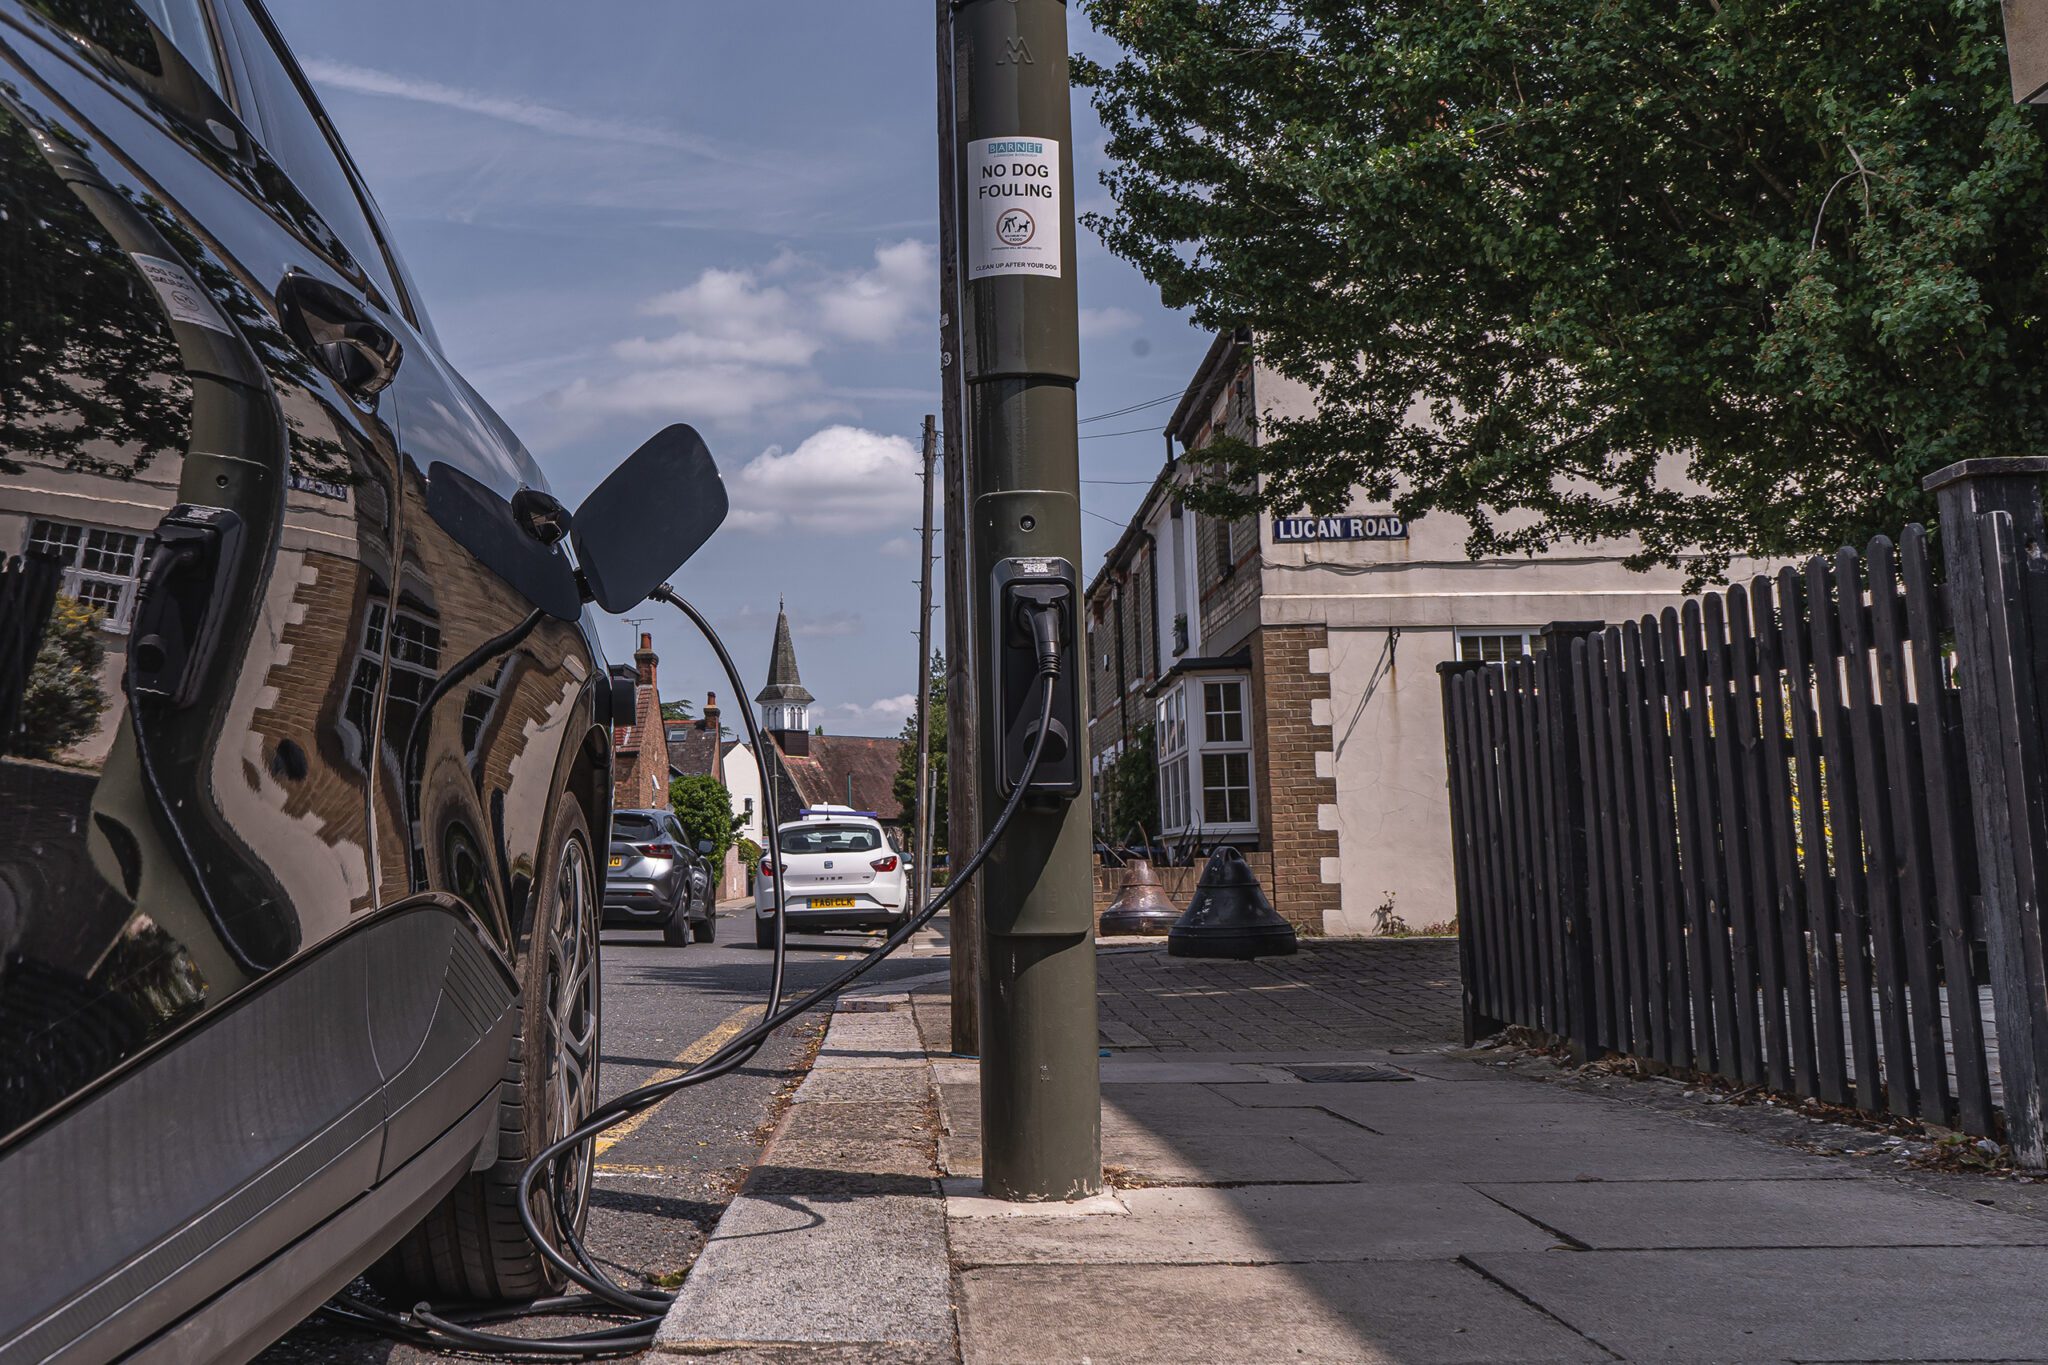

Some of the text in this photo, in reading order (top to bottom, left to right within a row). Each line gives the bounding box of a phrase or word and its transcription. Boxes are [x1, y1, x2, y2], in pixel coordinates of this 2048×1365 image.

[989, 143, 1042, 153] BARNET
[982, 163, 1049, 179] NO DOG
[979, 183, 1052, 199] FOULING
[976, 263, 996, 271] CLEAN
[1280, 518, 1402, 539] LUCAN ROAD
